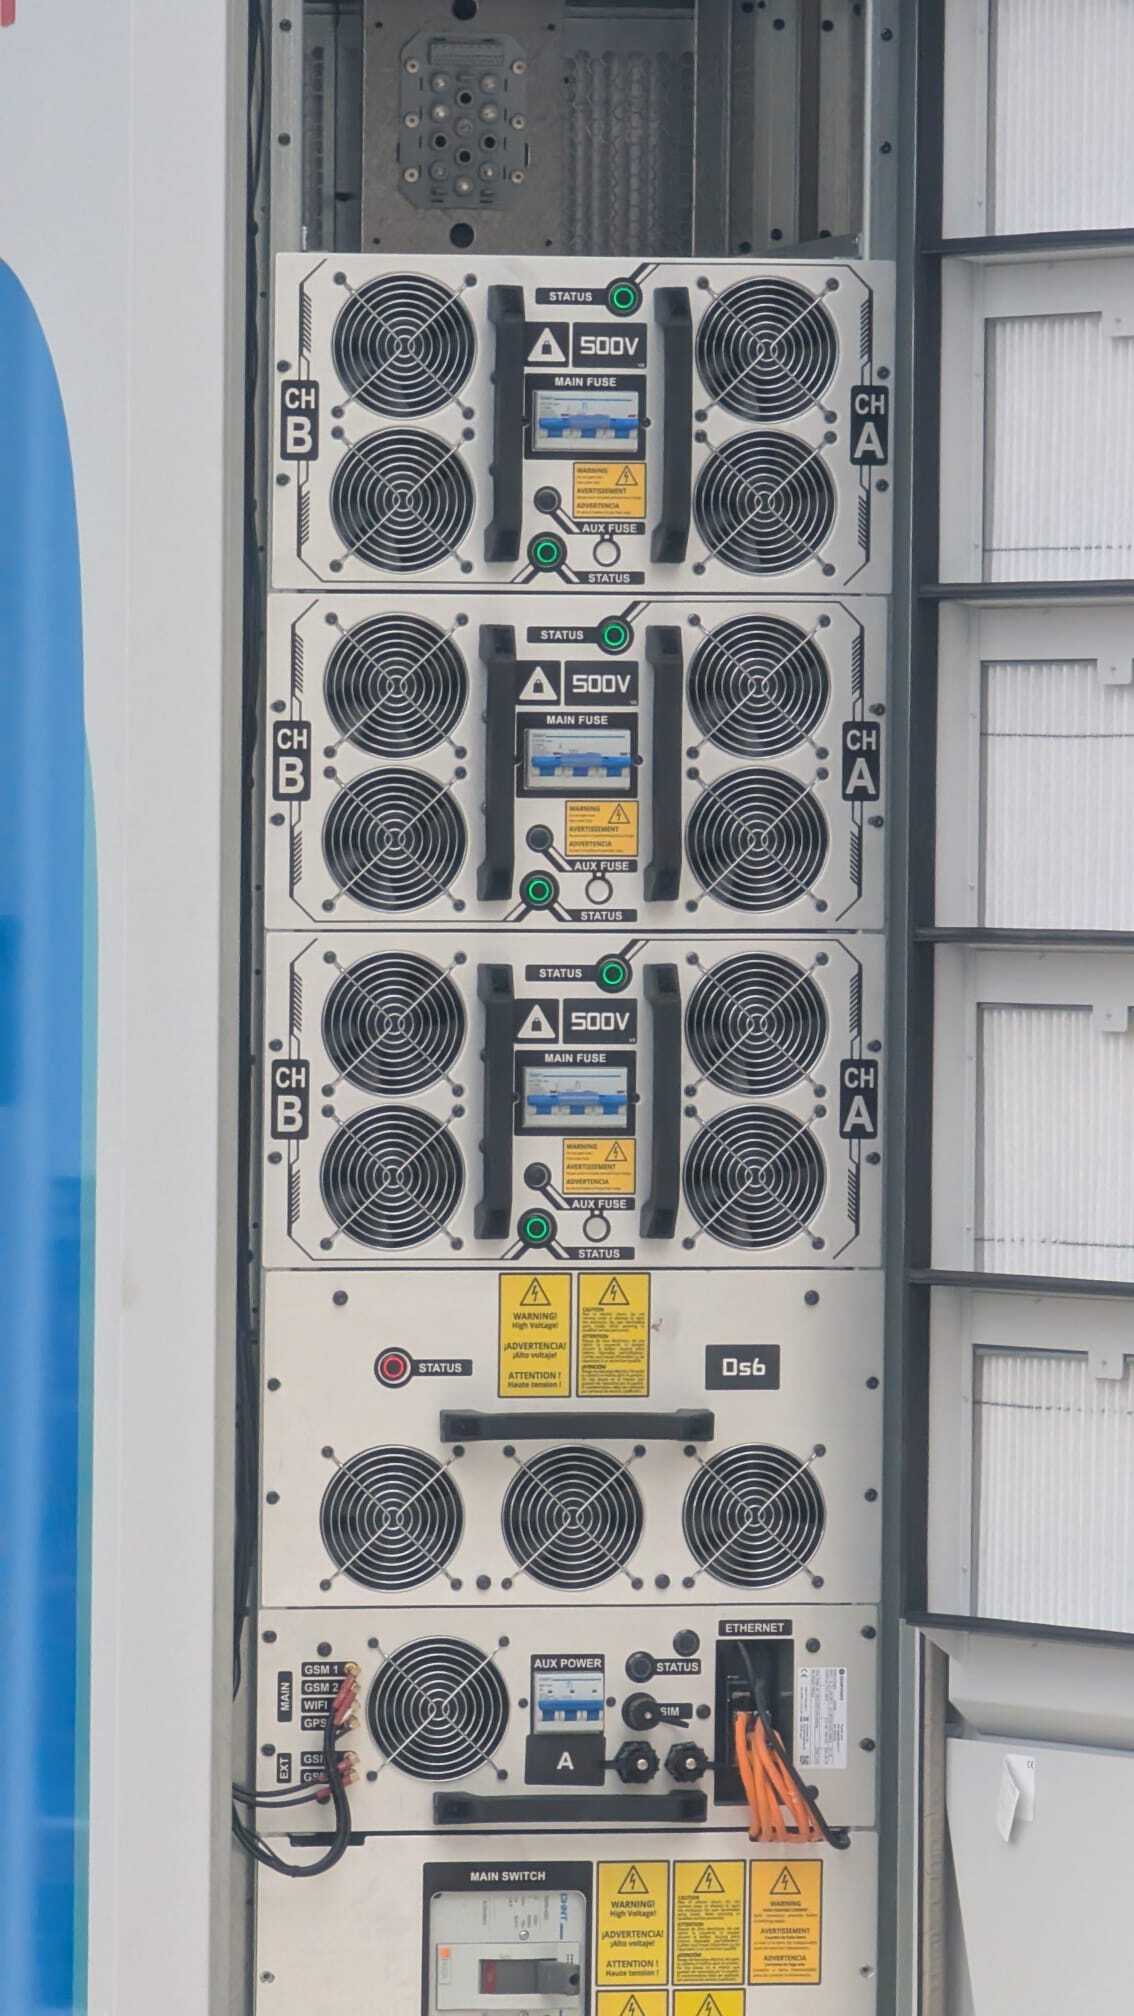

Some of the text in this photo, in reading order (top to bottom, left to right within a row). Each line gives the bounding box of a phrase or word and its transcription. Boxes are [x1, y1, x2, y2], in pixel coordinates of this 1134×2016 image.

[549, 292, 592, 301] STATUS
[580, 336, 639, 355] 500V
[554, 378, 616, 386] MAIN FUSE
[286, 388, 315, 408] CH
[855, 394, 884, 414] CH
[287, 416, 312, 453] B
[854, 422, 884, 458] A
[582, 524, 637, 532] AUX FUSE
[588, 574, 630, 583] STATUS
[541, 630, 584, 640] STATUS
[572, 675, 631, 693] 500V
[546, 716, 608, 724] MAIN FUSE
[278, 728, 307, 749] CH
[847, 730, 876, 750] CH
[279, 756, 304, 793] B
[846, 758, 876, 794] A
[574, 862, 629, 870] AUX FUSE
[580, 912, 622, 920] STATUS
[540, 969, 582, 978] STATUS
[571, 1012, 630, 1030] 500V
[544, 1054, 606, 1062] MAIN FUSE
[276, 1067, 306, 1088] CH
[844, 1067, 874, 1088] CH
[277, 1096, 302, 1132] B
[843, 1096, 874, 1132] A
[572, 1200, 627, 1208] AUX FUSE
[578, 1249, 620, 1258] STATUS
[512, 1312, 558, 1320] WARNING!
[512, 1322, 528, 1330] High
[418, 1363, 462, 1372] STATUS
[508, 1372, 556, 1380] ATTENTION
[726, 1623, 784, 1632] ETHERNET
[534, 1658, 602, 1668] AUX POWER
[656, 1662, 698, 1672] STATUS
[304, 1665, 338, 1674] GSM 1
[304, 1682, 339, 1692] GSM 2
[280, 1682, 290, 1711] MAIN
[304, 1700, 328, 1710] WIFI
[660, 1706, 680, 1716] SIM
[304, 1718, 327, 1728] GPS
[556, 1752, 574, 1770] A
[280, 1757, 288, 1779] EXT
[470, 1872, 546, 1881] MAIN SWITCH
[606, 1960, 654, 1968] ATTENTION
